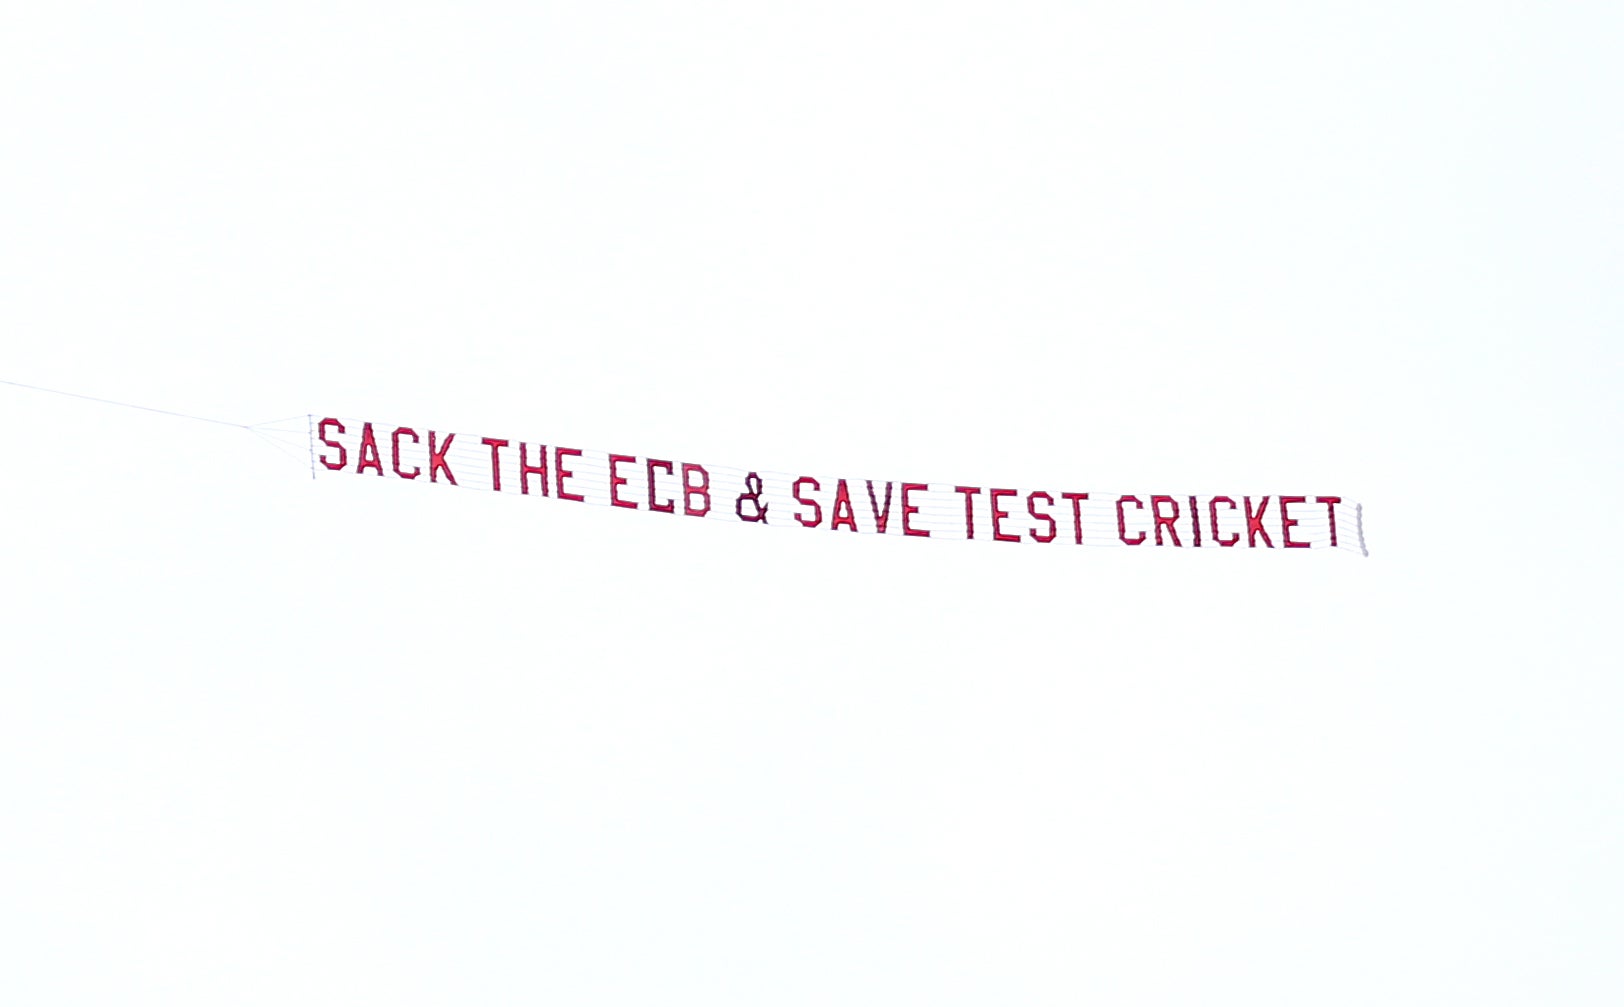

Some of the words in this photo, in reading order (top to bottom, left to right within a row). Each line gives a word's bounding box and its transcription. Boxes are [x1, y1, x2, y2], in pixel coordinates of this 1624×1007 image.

[318, 417, 458, 486] SACK
[481, 437, 585, 503] THE
[608, 453, 711, 518] ECB
[735, 471, 769, 525] &
[792, 476, 930, 538] SAVE
[954, 485, 1089, 545] TEST
[1116, 494, 1342, 549] CRICKET
